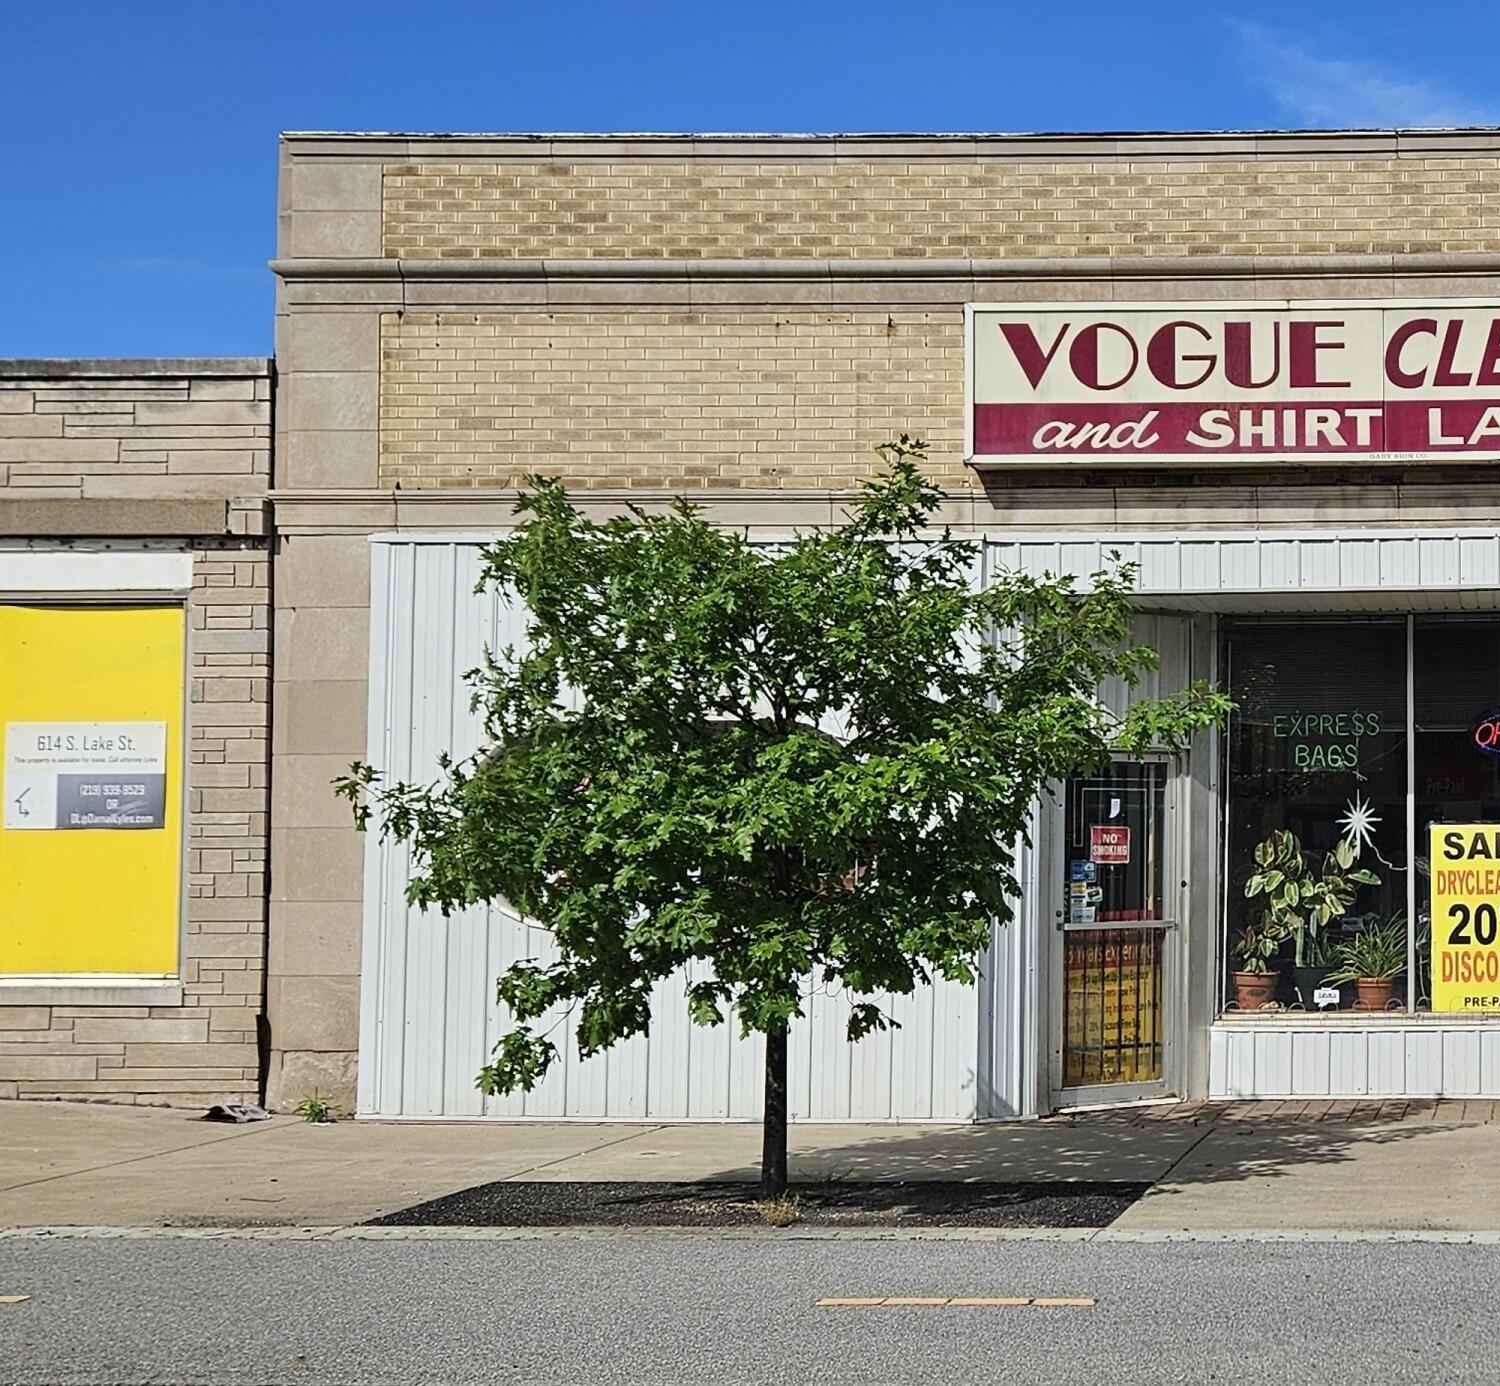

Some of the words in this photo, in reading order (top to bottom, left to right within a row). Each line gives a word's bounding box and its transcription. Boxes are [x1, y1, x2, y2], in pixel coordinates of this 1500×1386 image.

[998, 320, 1352, 391] VOGUE
[1032, 410, 1161, 450] and
[1186, 409, 1383, 448] SHIRT
[1273, 713, 1380, 737] EXPRESS
[37, 735, 61, 751] 614
[66, 735, 78, 751] S.
[83, 735, 114, 751] Lake
[118, 735, 136, 751] St.
[1295, 744, 1358, 767] BAGS
[106, 798, 118, 810] OR
[1102, 833, 1118, 844] NO
[1093, 845, 1128, 856] SMOKING
